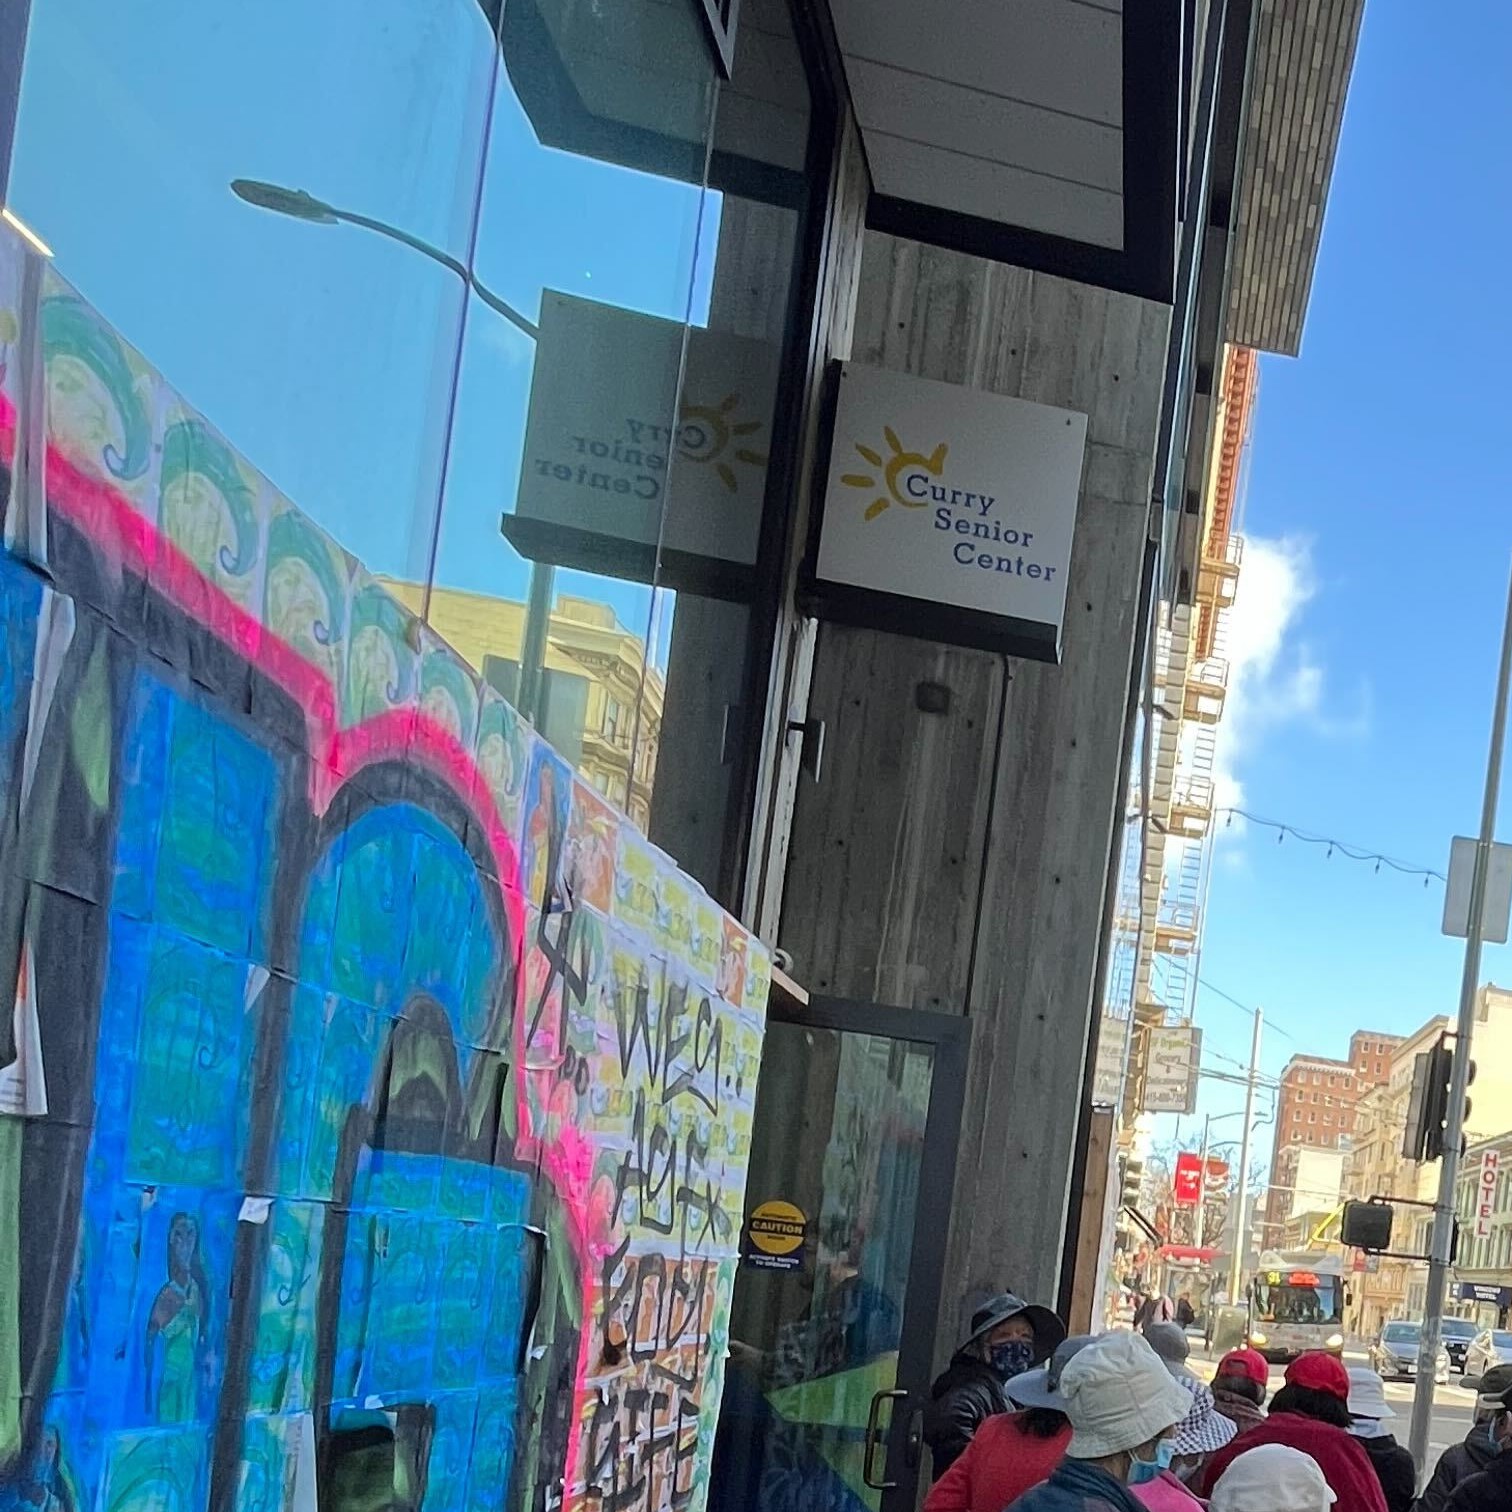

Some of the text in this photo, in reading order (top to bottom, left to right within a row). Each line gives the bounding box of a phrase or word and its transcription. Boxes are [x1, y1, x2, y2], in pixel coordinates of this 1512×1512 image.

[906, 474, 996, 516] Curry
[934, 507, 1034, 547] Senior
[953, 542, 1057, 581] Center
[1478, 1153, 1498, 1235] HOTEL
[752, 1220, 803, 1235] CAUTION
